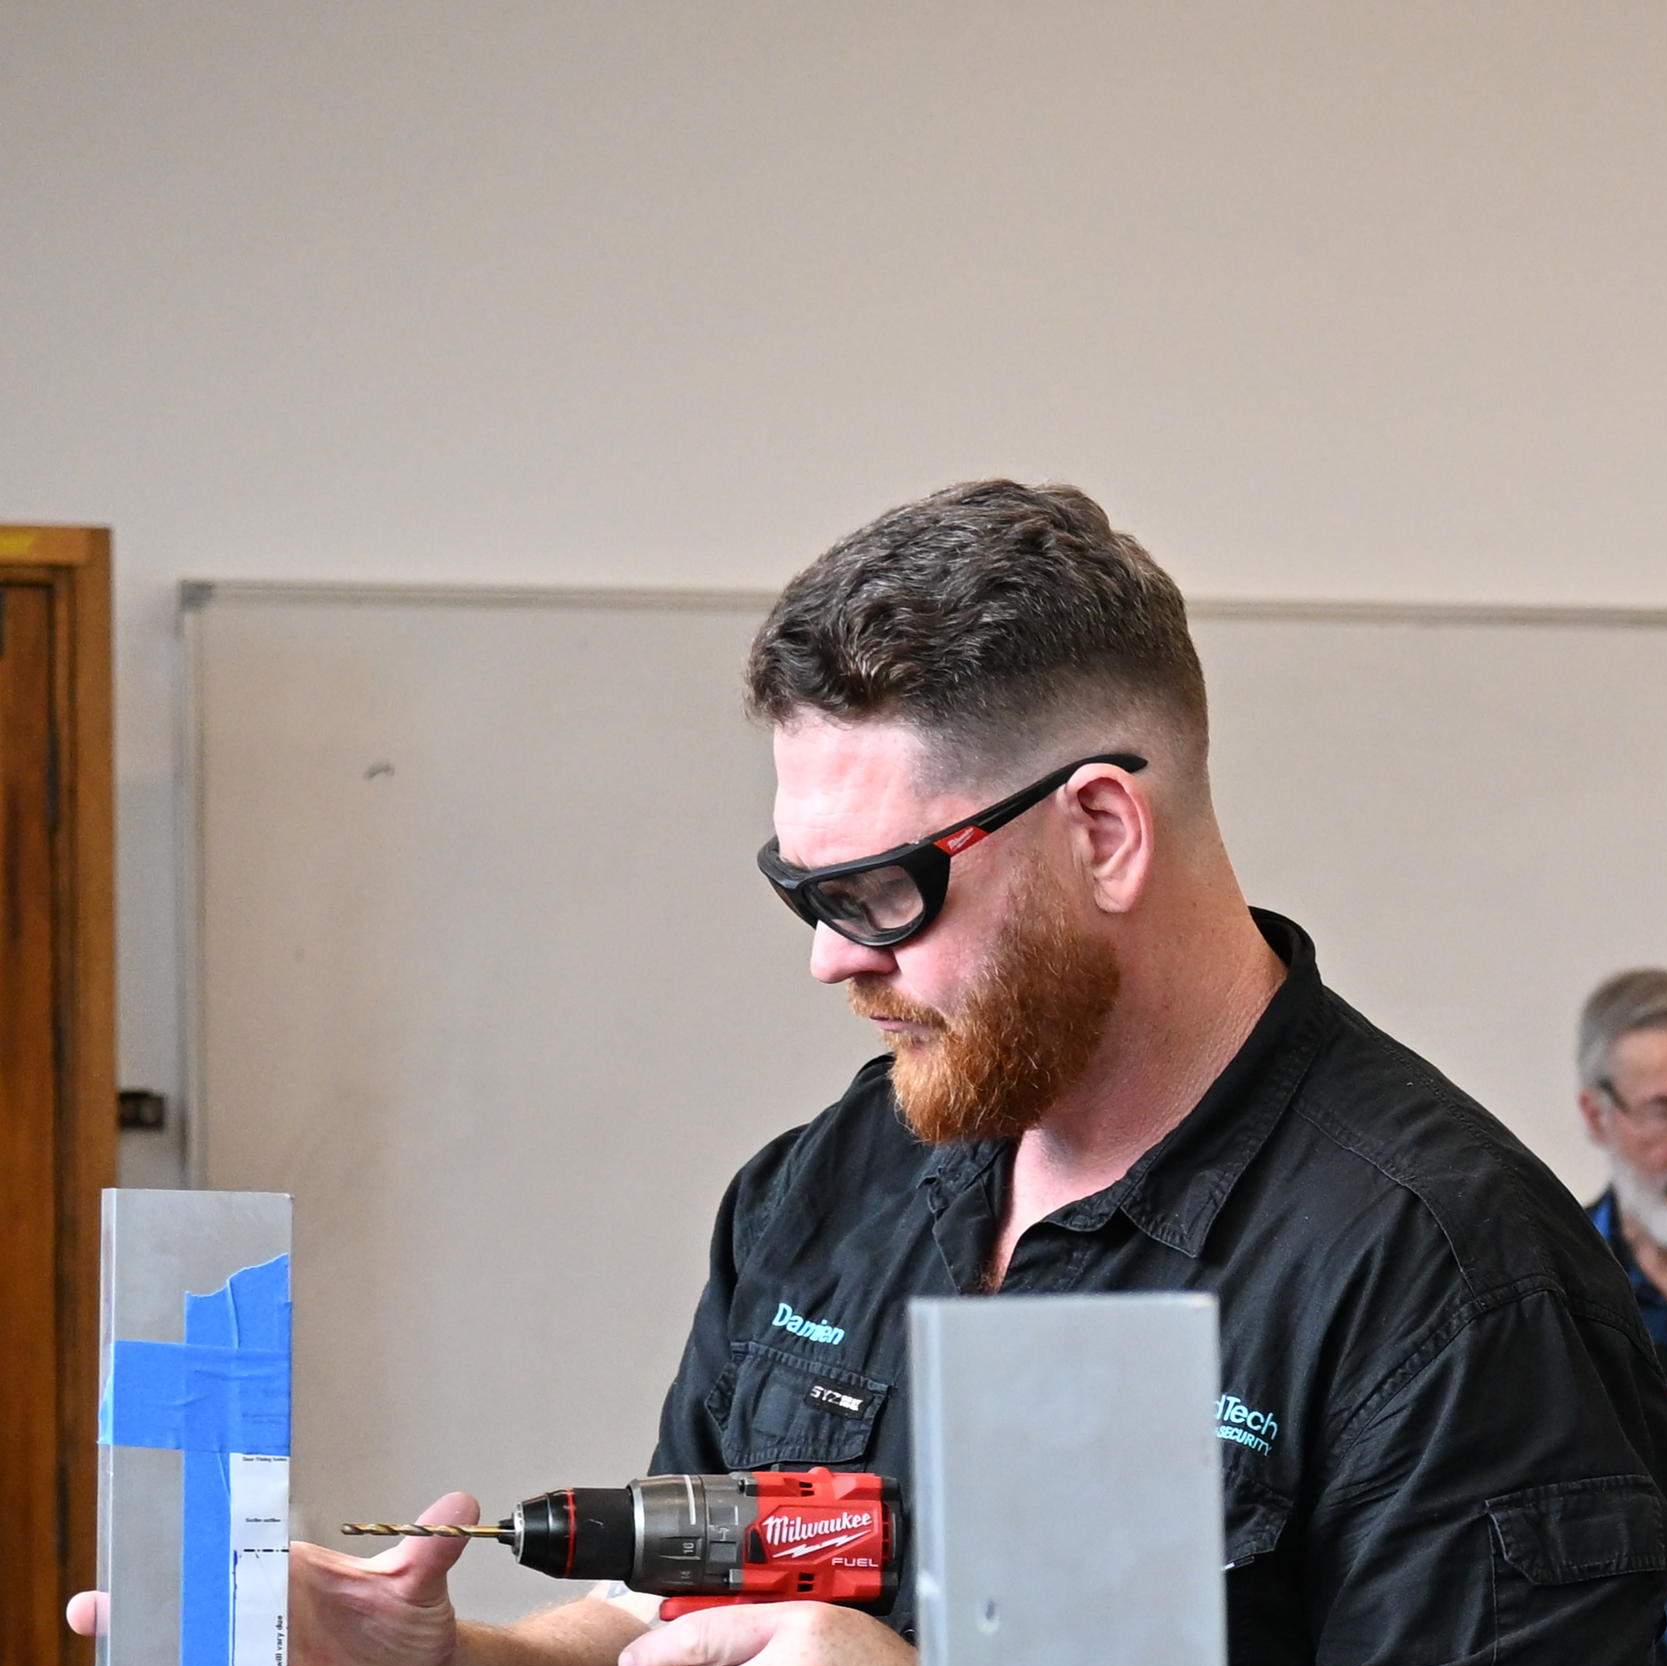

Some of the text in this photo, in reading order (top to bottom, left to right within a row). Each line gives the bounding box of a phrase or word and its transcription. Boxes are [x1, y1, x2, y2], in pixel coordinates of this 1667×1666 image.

[771, 1302, 846, 1346] Damien
[761, 1511, 873, 1547] Milwaukee
[831, 1557, 880, 1568] FUEL
[274, 1615, 284, 1631] due
[276, 1632, 286, 1651] vary
